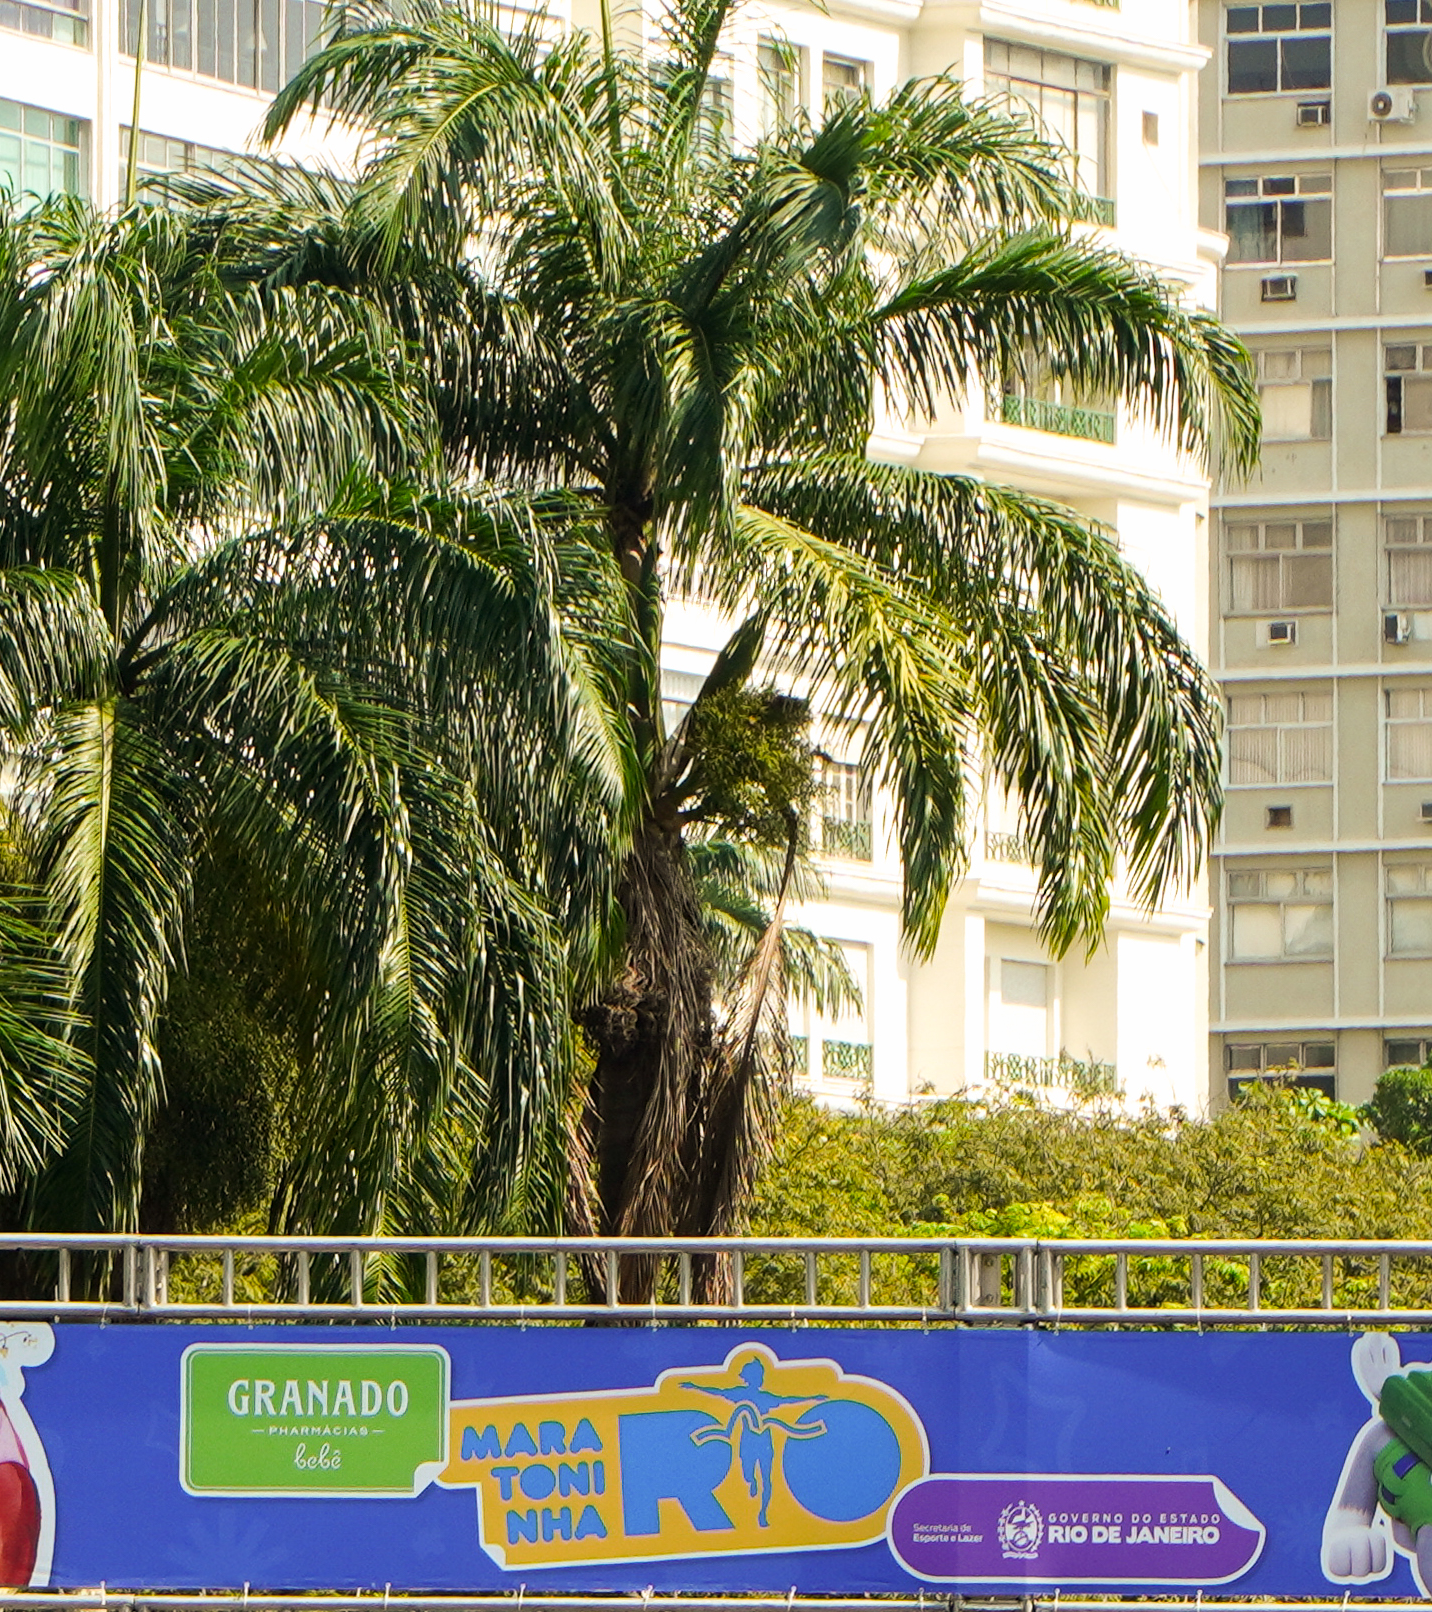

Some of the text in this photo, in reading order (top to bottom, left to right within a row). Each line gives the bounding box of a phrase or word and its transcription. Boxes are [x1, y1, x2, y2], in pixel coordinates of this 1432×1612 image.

[227, 1378, 409, 1418] GRANADO
[293, 1442, 342, 1470] bebê
[460, 1417, 604, 1461] MARA
[491, 1461, 606, 1501] TONI
[505, 1504, 609, 1545] NHA
[1047, 1512, 1221, 1525] GOVERNO DO ESTADO
[1047, 1525, 1221, 1545] RIO DE JANEIRO
